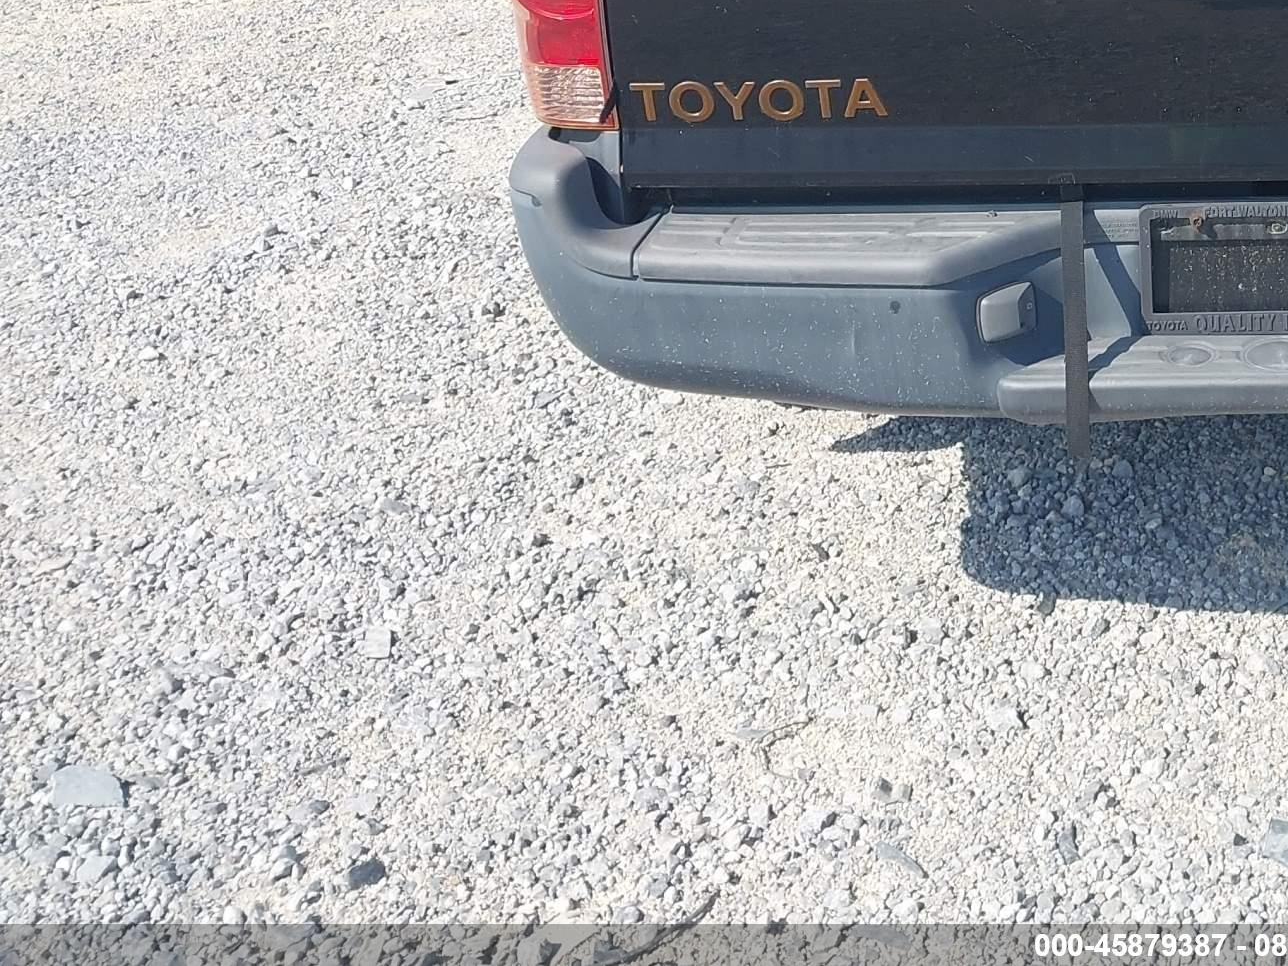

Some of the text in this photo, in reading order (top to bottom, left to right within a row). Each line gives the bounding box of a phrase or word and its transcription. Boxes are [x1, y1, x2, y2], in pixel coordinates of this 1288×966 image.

[629, 78, 889, 123] TOYOTA
[1153, 209, 1179, 219] BMW
[1204, 206, 1236, 218] FORT
[1239, 205, 1287, 218] WALTON
[1146, 321, 1188, 331] TOYOTA
[1195, 314, 1277, 333] QUALITY
